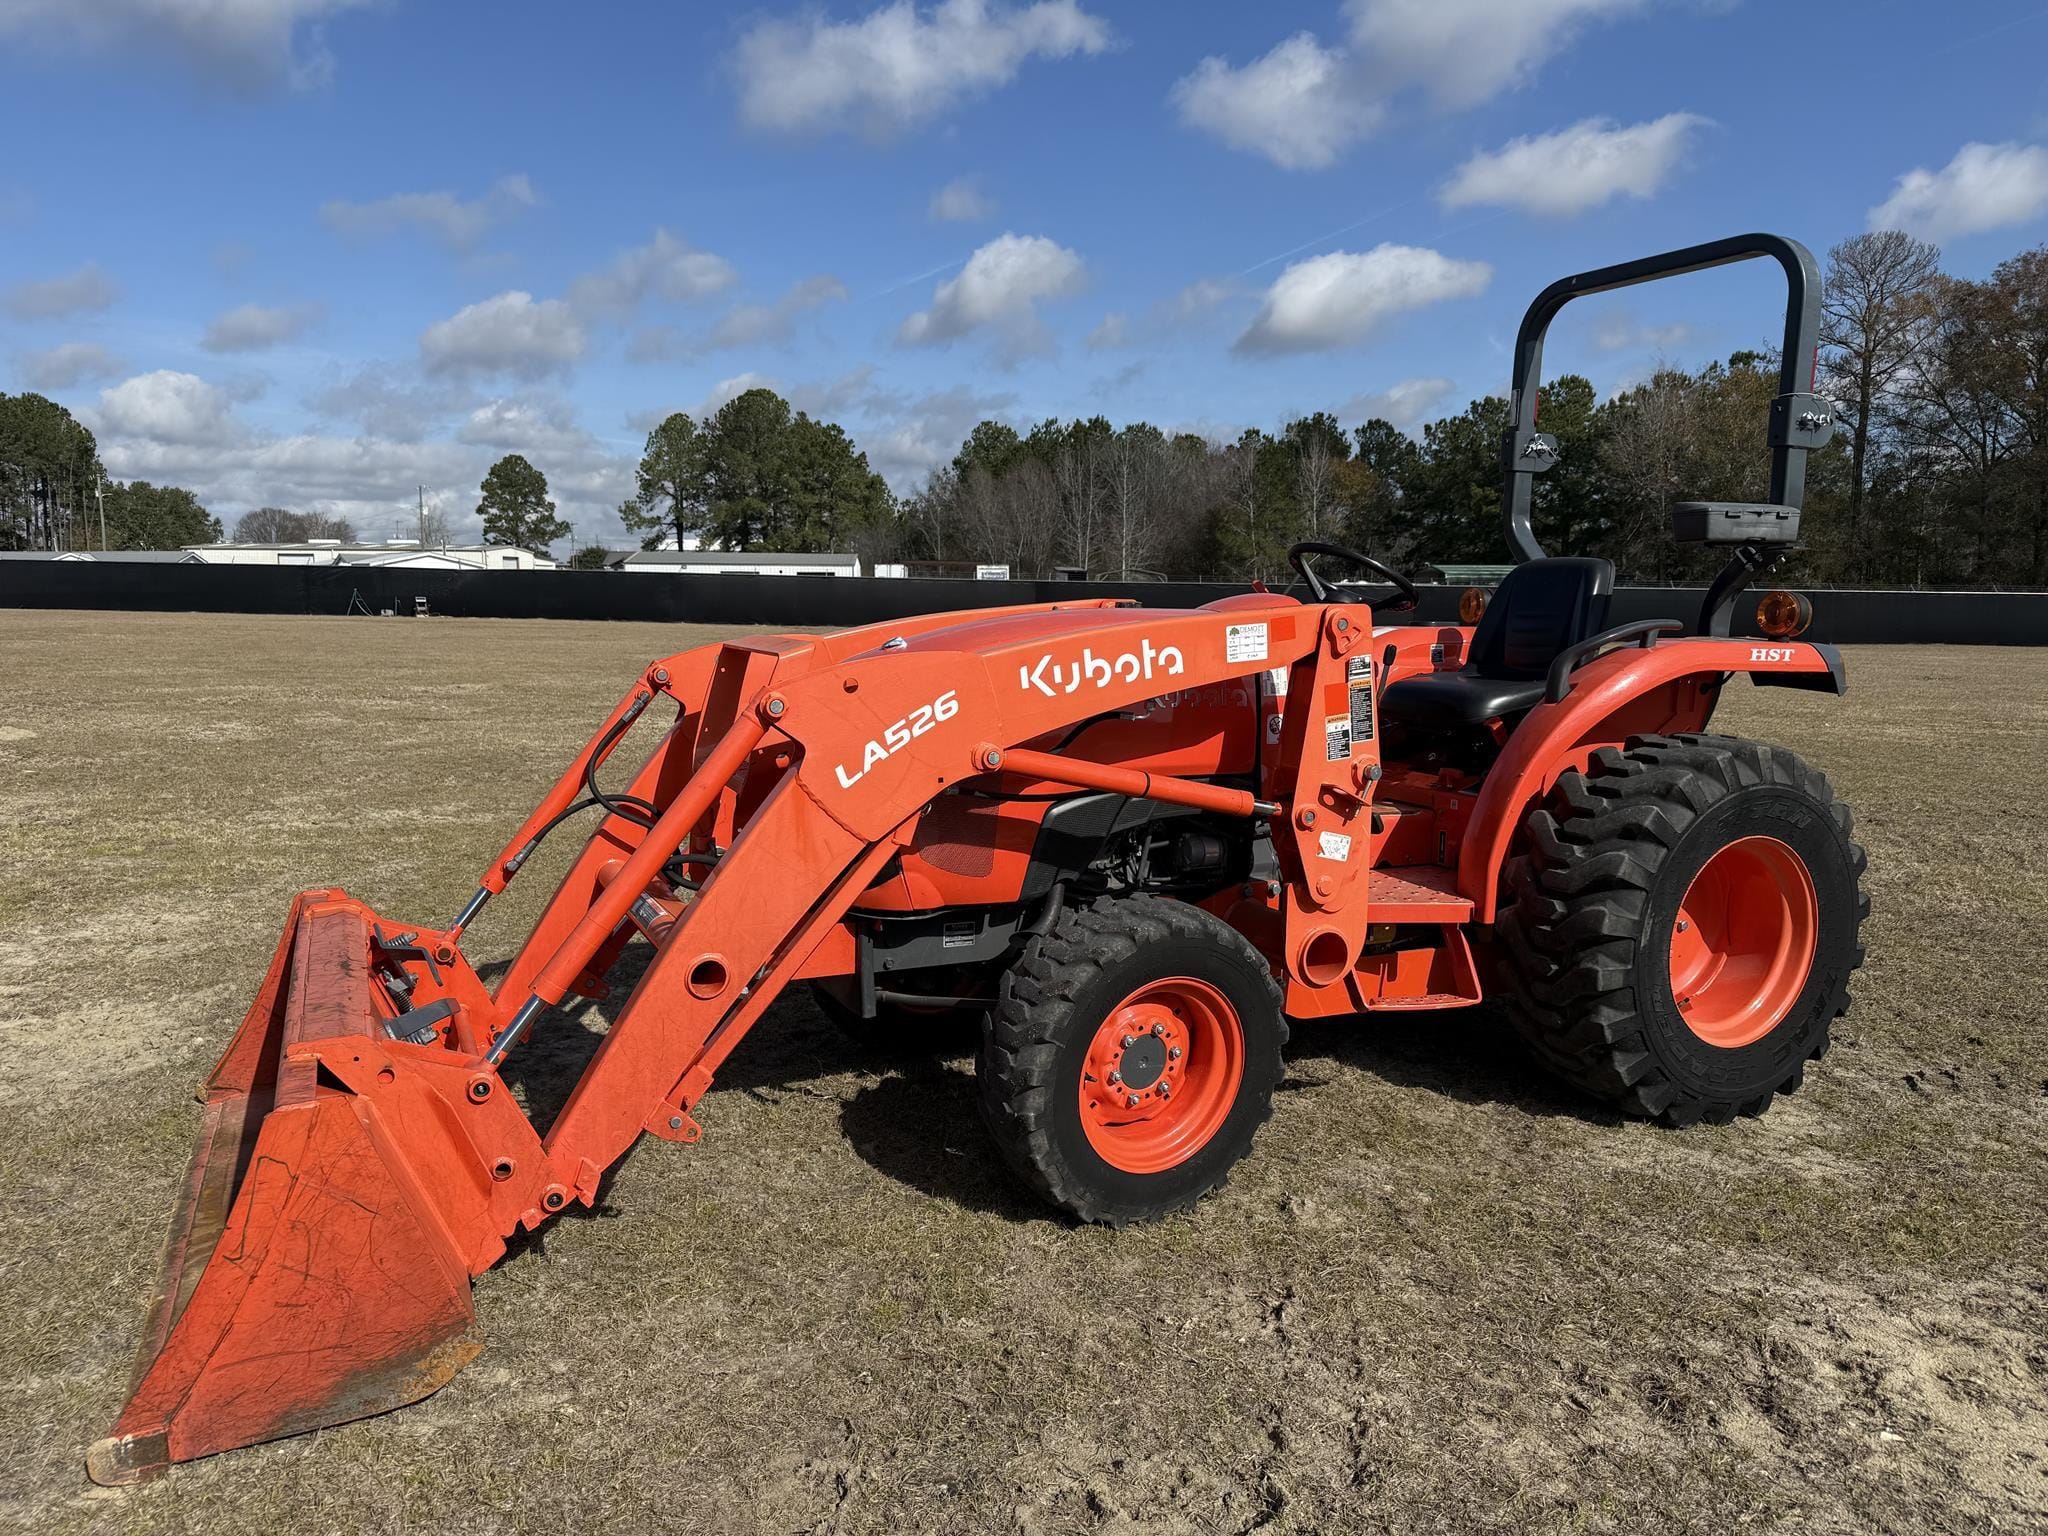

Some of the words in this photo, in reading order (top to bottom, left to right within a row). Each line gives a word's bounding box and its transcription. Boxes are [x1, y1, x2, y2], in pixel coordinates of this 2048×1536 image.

[1019, 638, 1185, 697] Kubota
[1749, 648, 1795, 662] HST
[835, 690, 960, 789] LA526
